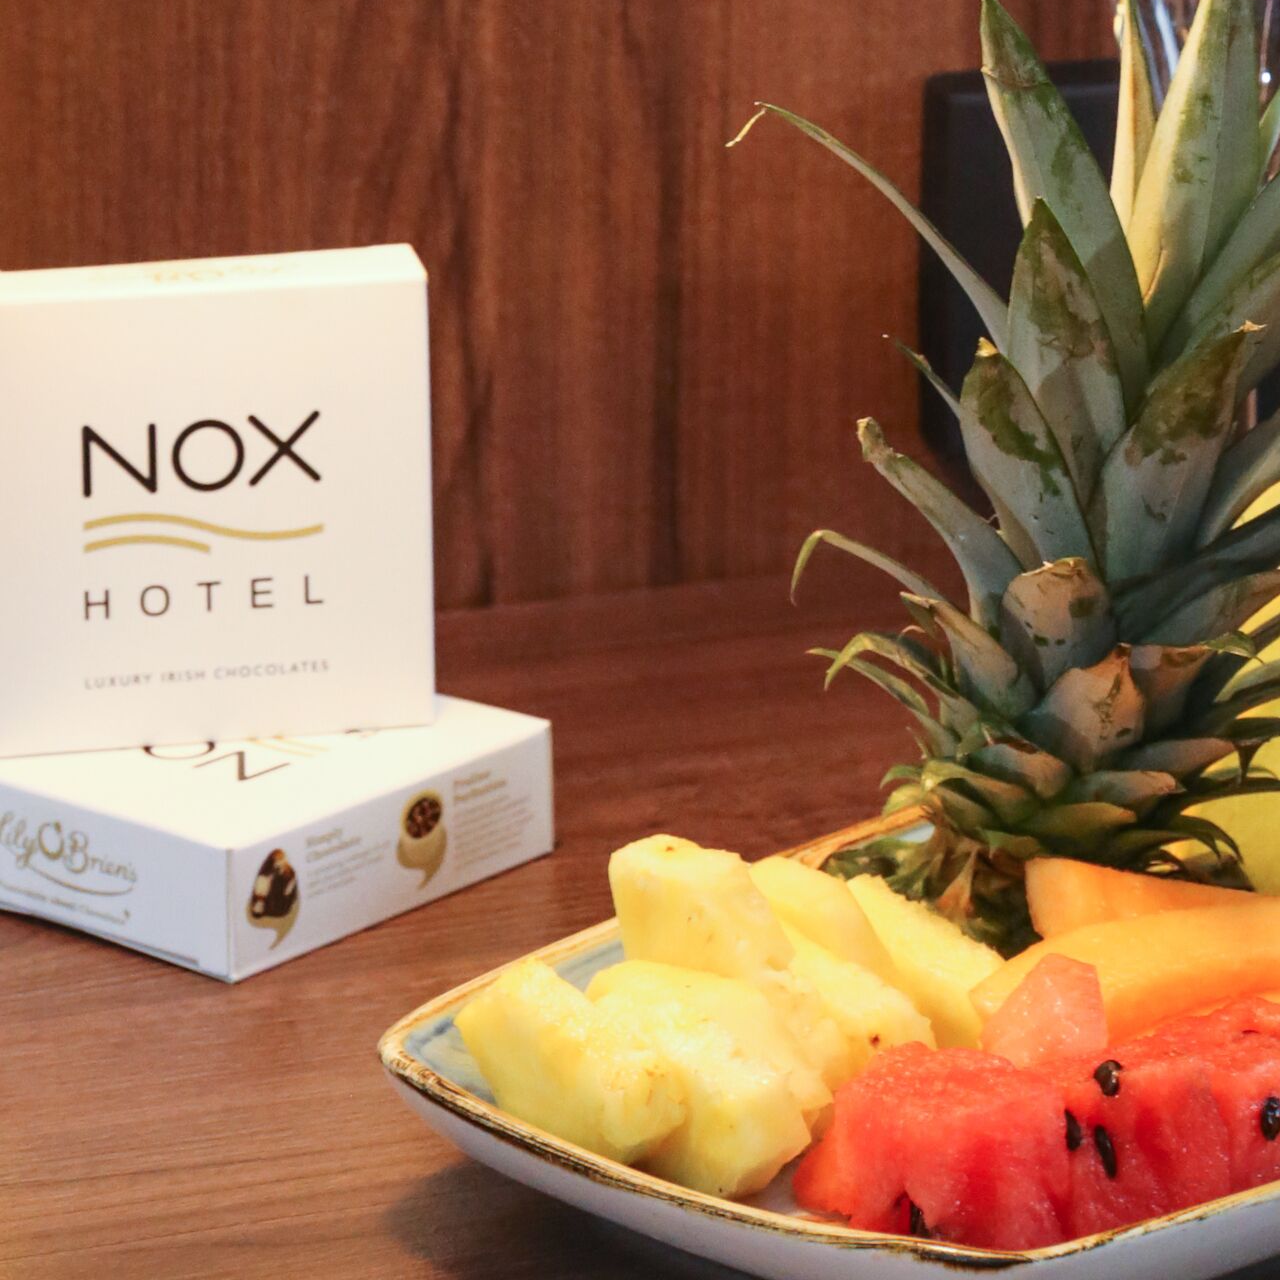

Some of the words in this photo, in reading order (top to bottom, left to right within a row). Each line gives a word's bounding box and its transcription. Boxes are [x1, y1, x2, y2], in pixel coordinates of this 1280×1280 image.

[81, 410, 322, 498] NOX
[83, 574, 326, 621] HOTEL
[84, 673, 152, 690] LUXURY
[160, 669, 206, 684] IRISH
[213, 659, 331, 680] CHOCOLATES
